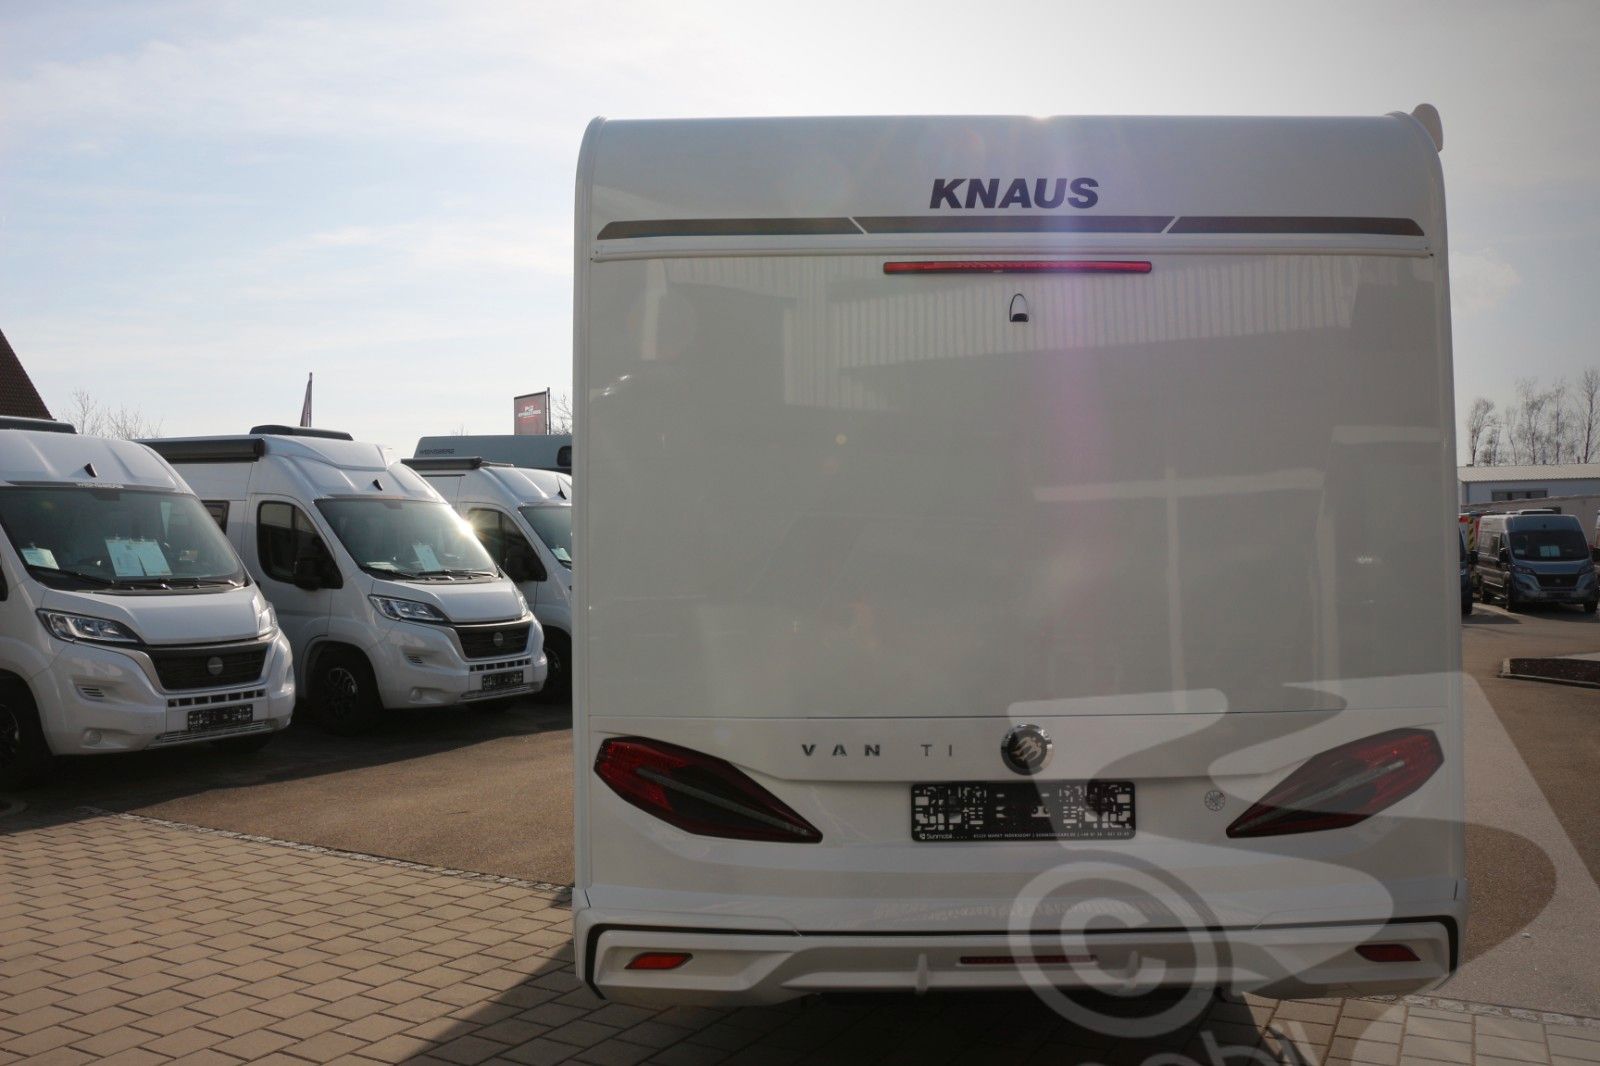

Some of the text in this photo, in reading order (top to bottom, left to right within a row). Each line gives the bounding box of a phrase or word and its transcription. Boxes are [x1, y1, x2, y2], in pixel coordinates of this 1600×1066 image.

[929, 177, 1099, 209] KNAUS
[801, 743, 953, 757] VAN TI
